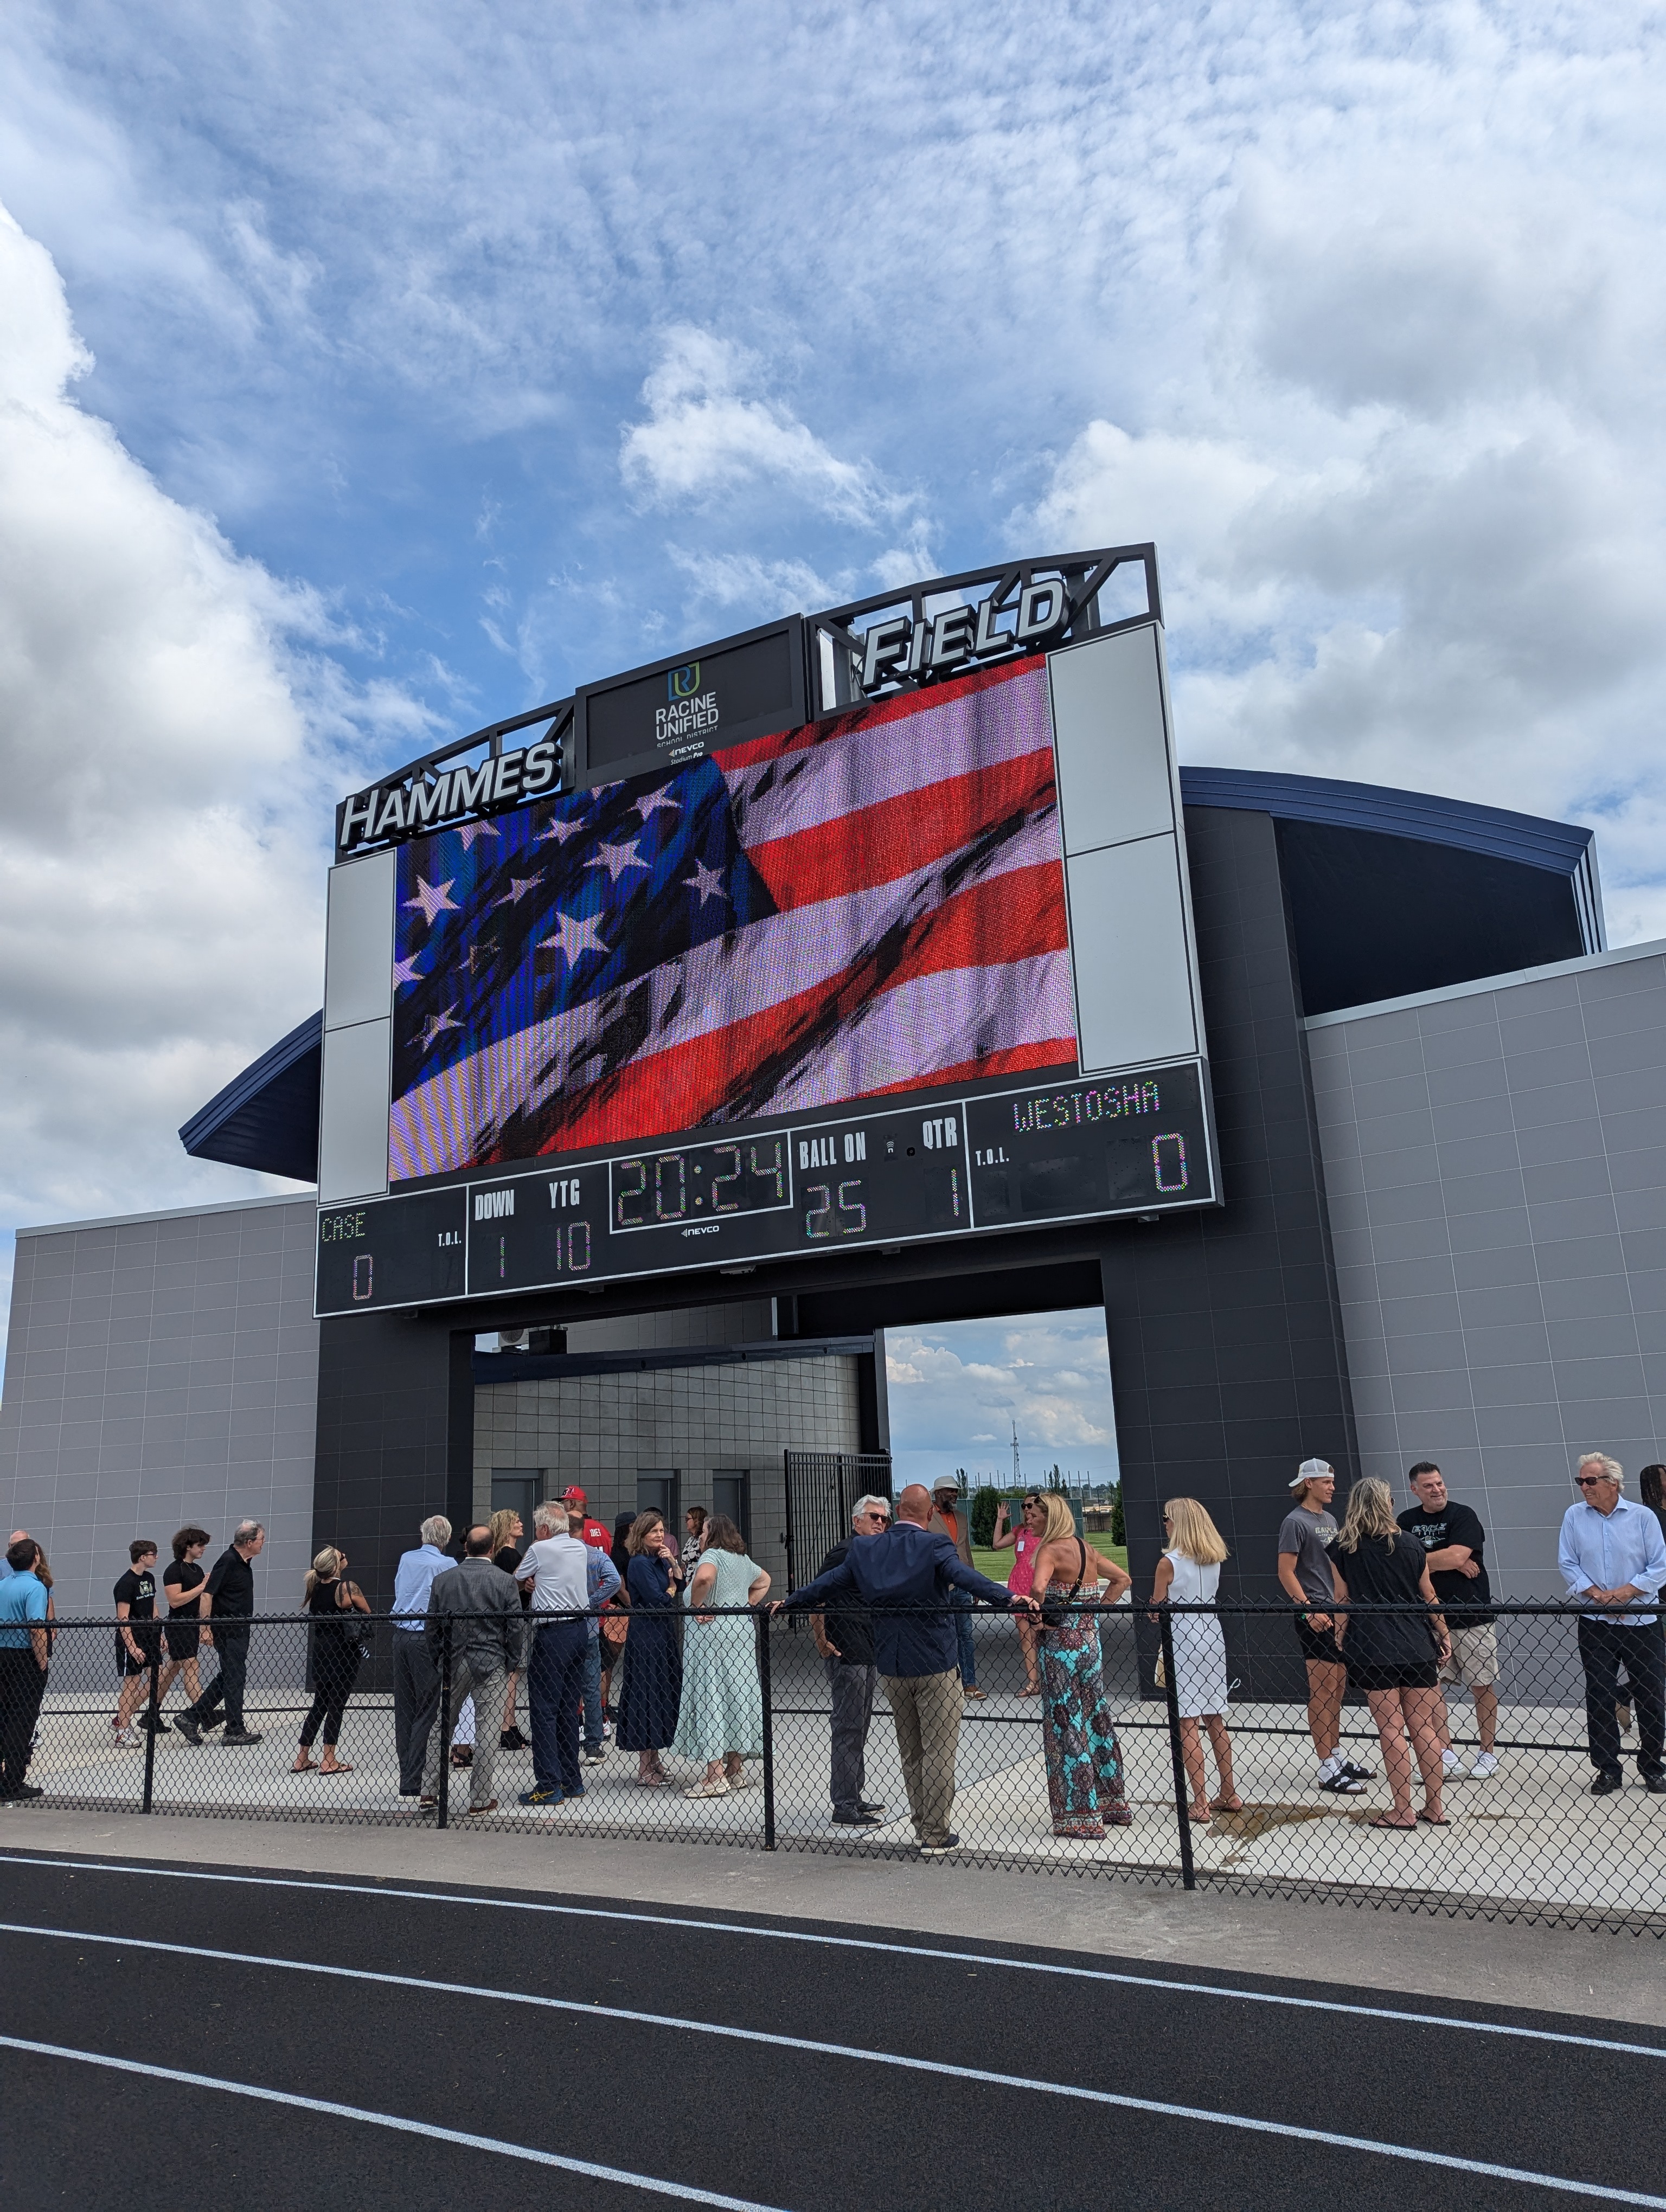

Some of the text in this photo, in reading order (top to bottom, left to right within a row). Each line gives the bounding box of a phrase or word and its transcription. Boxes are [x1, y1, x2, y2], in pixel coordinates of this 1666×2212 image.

[861, 578, 1069, 690] FIELD
[656, 691, 716, 724] RACINE
[656, 708, 719, 740] UNIFIED
[670, 754, 693, 766] Stadium
[338, 740, 559, 848] HAMMES
[1013, 1081, 1160, 1133] WESTOSHA
[799, 1131, 866, 1170] BALL ON
[922, 1117, 958, 1150] QTR
[975, 1147, 1010, 1166] T.O.L.
[1151, 1132, 1188, 1193] 0
[549, 1178, 580, 1209] YTG
[618, 1141, 784, 1226] 20:24
[951, 1168, 959, 1217] 1
[475, 1189, 515, 1221] DOWN
[806, 1180, 866, 1238] 25
[322, 1212, 366, 1243] CASE
[438, 1231, 462, 1247] T.O.L.
[556, 1221, 591, 1271] 10
[500, 1237, 505, 1278] 1
[353, 1255, 373, 1301] 0
